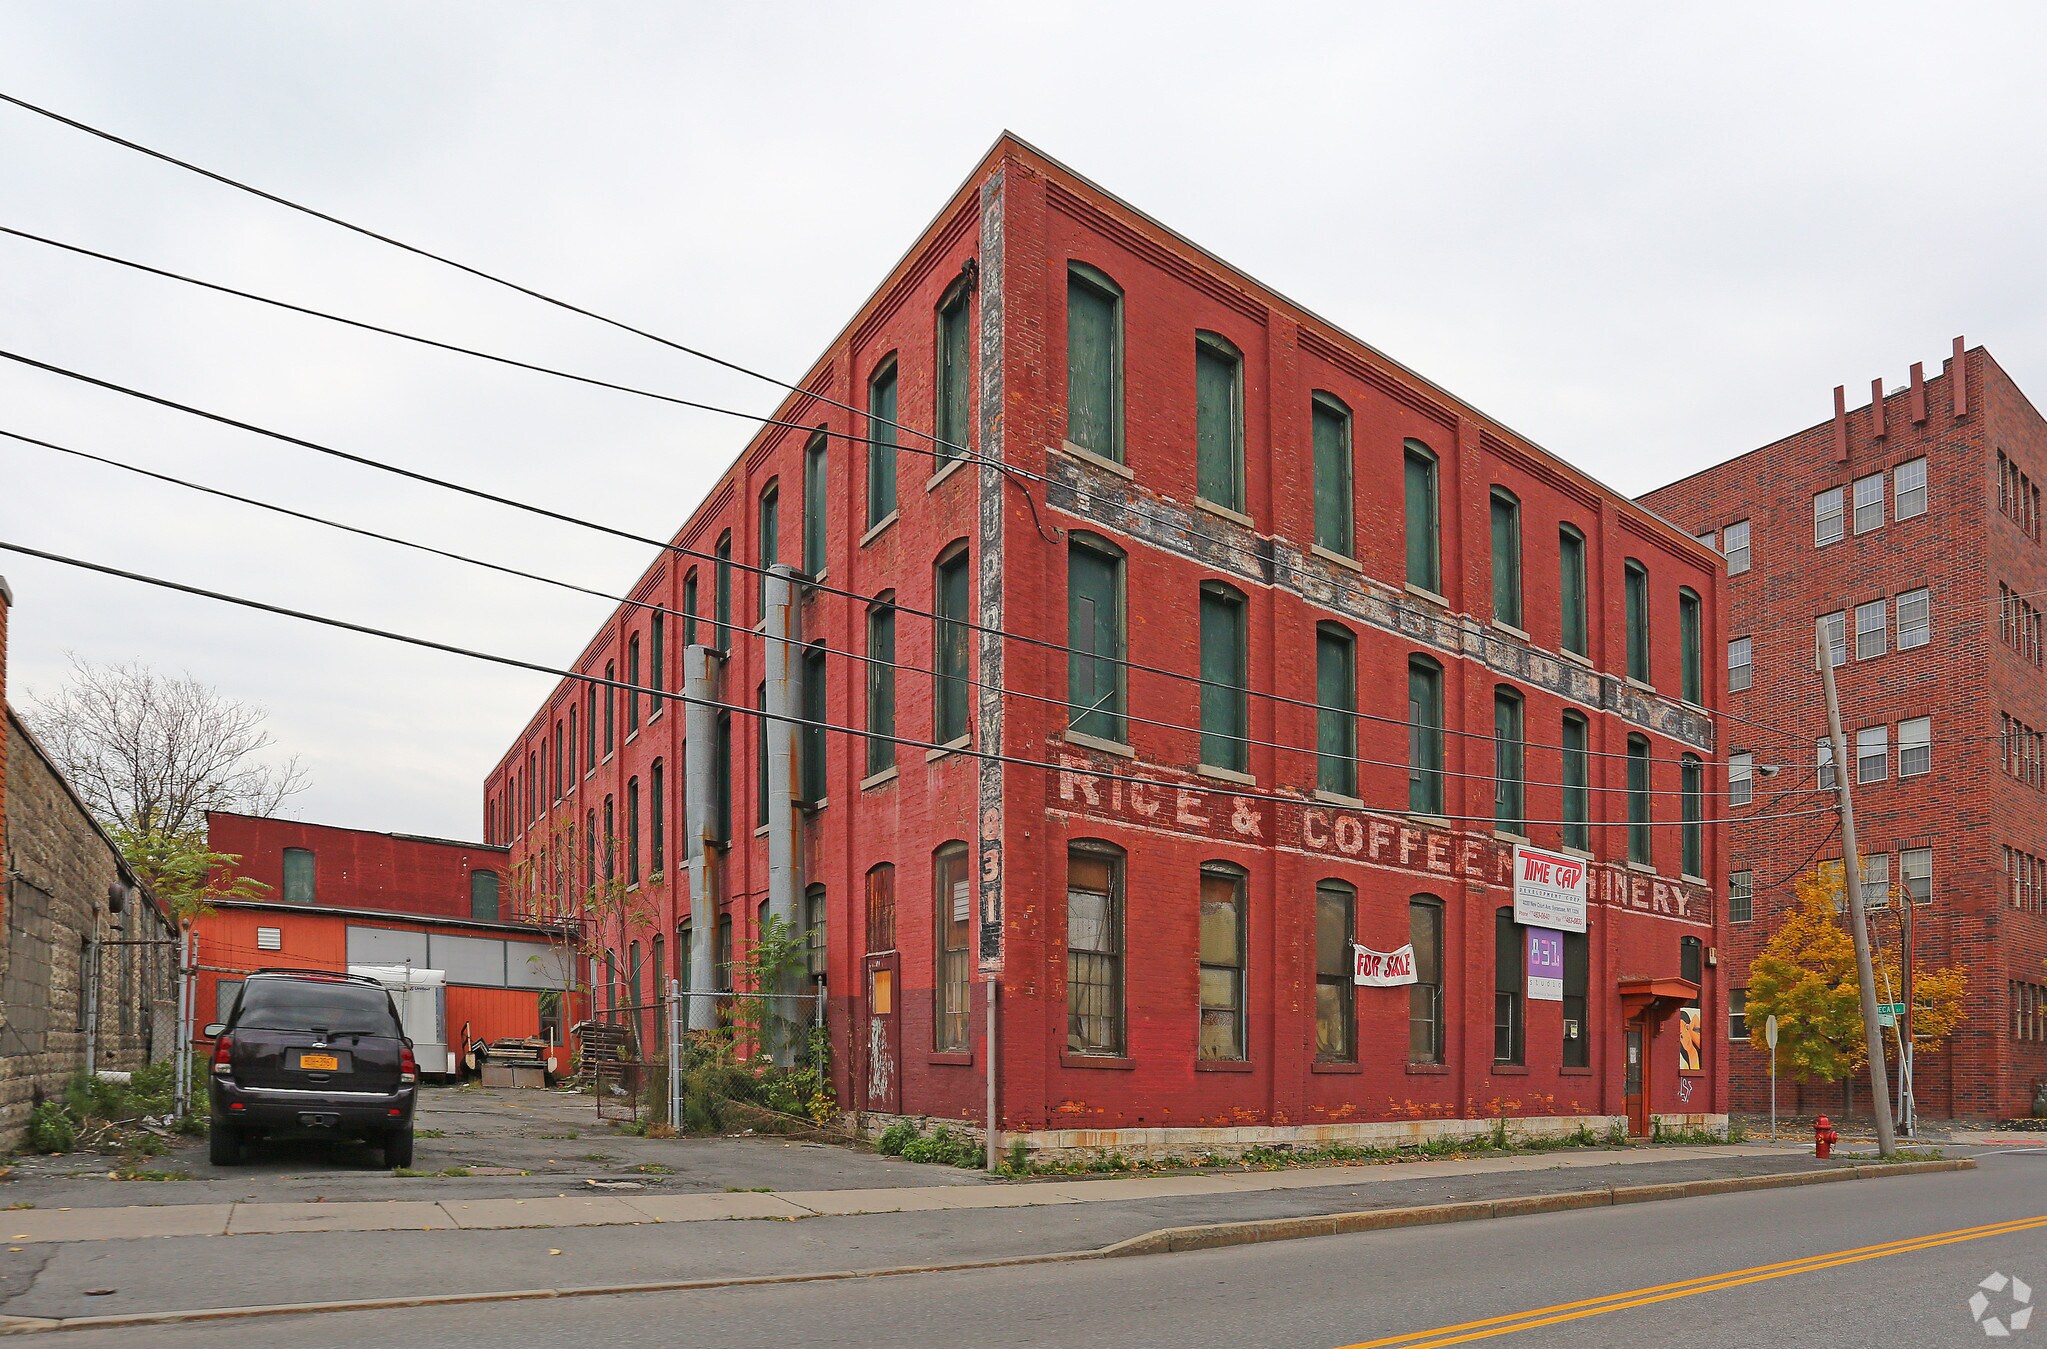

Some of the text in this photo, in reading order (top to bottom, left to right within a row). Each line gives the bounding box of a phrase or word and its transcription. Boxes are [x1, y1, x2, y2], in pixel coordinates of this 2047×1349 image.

[1060, 753, 1210, 829] RICE
[1231, 796, 1264, 839] &
[1303, 809, 1484, 878] COFFEE
[1519, 850, 1551, 884] TIME
[1519, 888, 1562, 899] DEVELOPMENT
[1357, 953, 1411, 978] FOR SALE
[1531, 938, 1560, 967] 831
